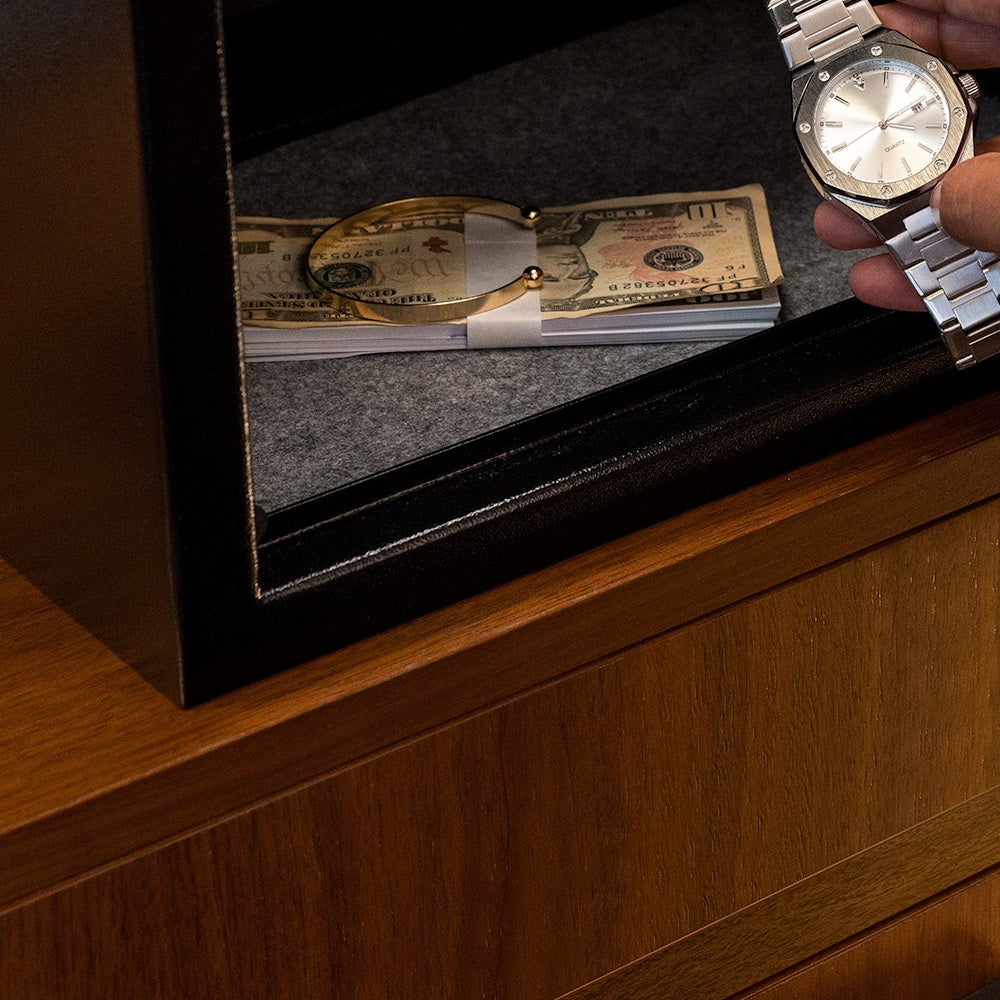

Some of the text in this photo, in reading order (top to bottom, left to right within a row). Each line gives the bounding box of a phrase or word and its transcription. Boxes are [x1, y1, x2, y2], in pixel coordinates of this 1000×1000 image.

[884, 139, 906, 153] QUARTZ
[623, 276, 709, 289] 32705382
[716, 273, 737, 282] PF
